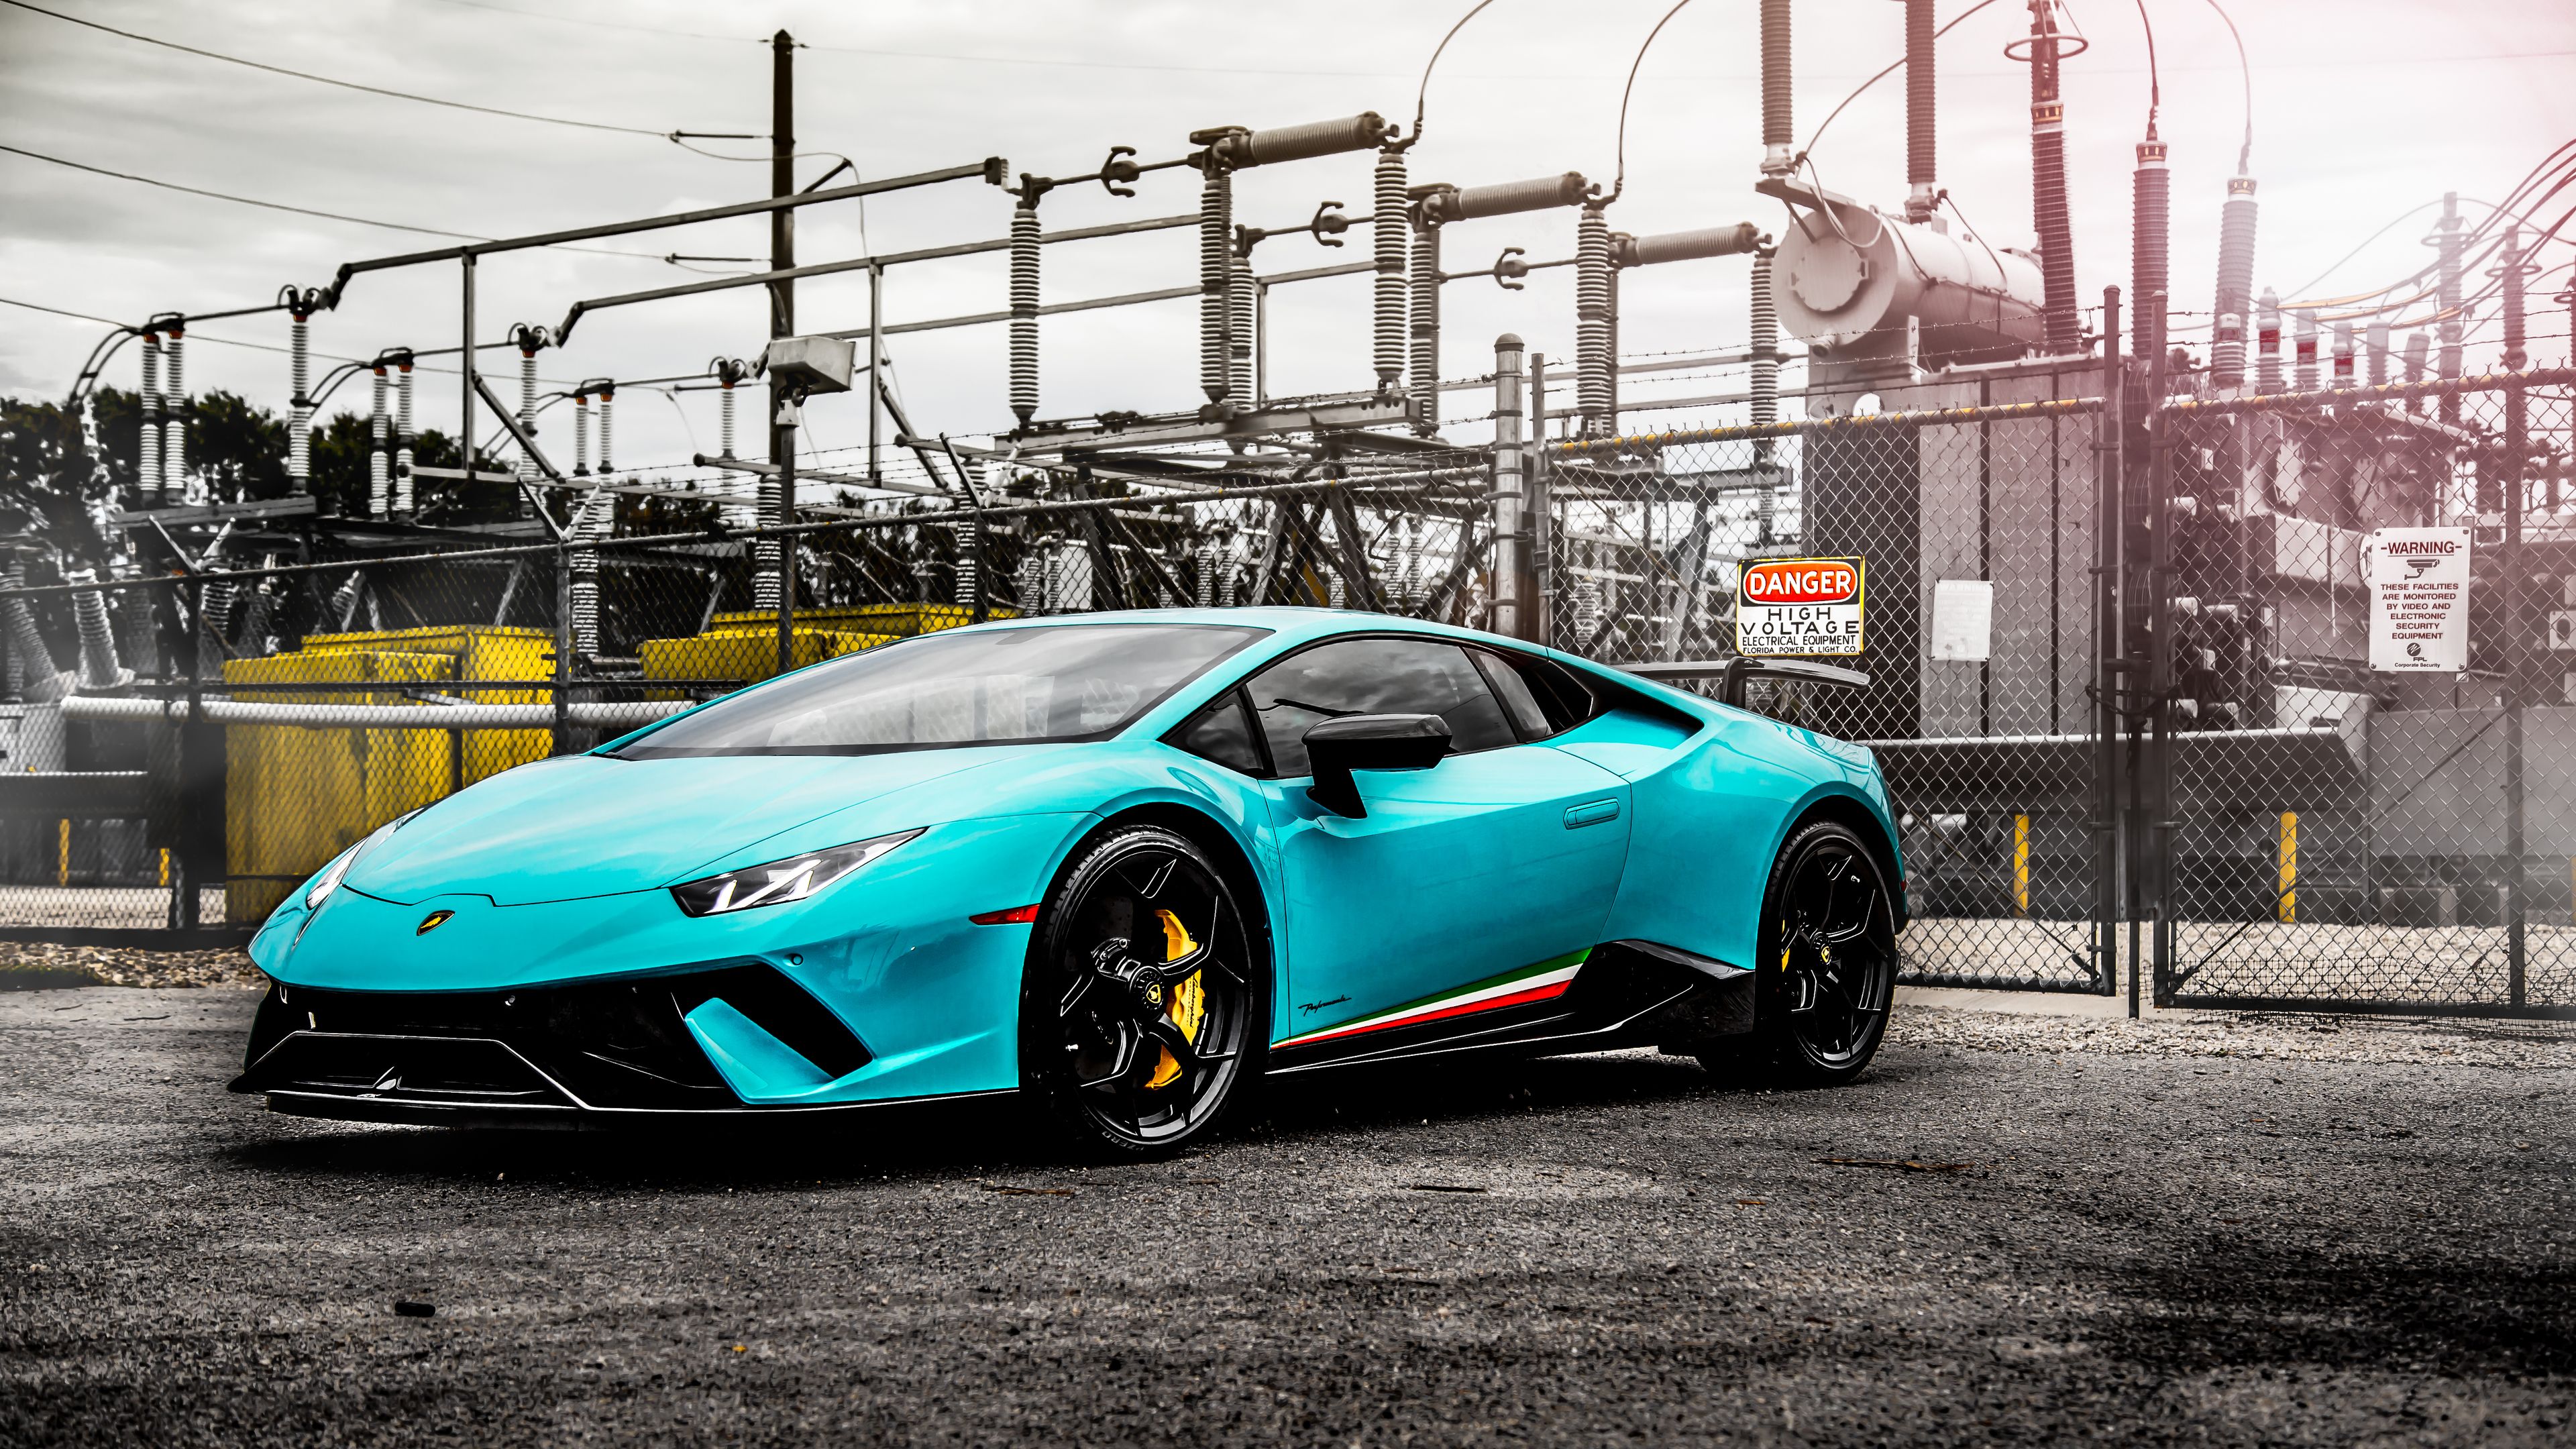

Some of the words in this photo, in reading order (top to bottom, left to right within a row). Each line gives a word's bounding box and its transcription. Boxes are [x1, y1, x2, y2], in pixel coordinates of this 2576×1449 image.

[1750, 570, 1851, 596] DANGER
[1768, 606, 1831, 621] HIGH
[1741, 621, 1859, 635] VOLTAGE
[1742, 636, 1799, 646] ELECTRICAL
[1803, 635, 1856, 645] EQUIPMENT
[1189, 975, 1198, 1028] Lamborghini
